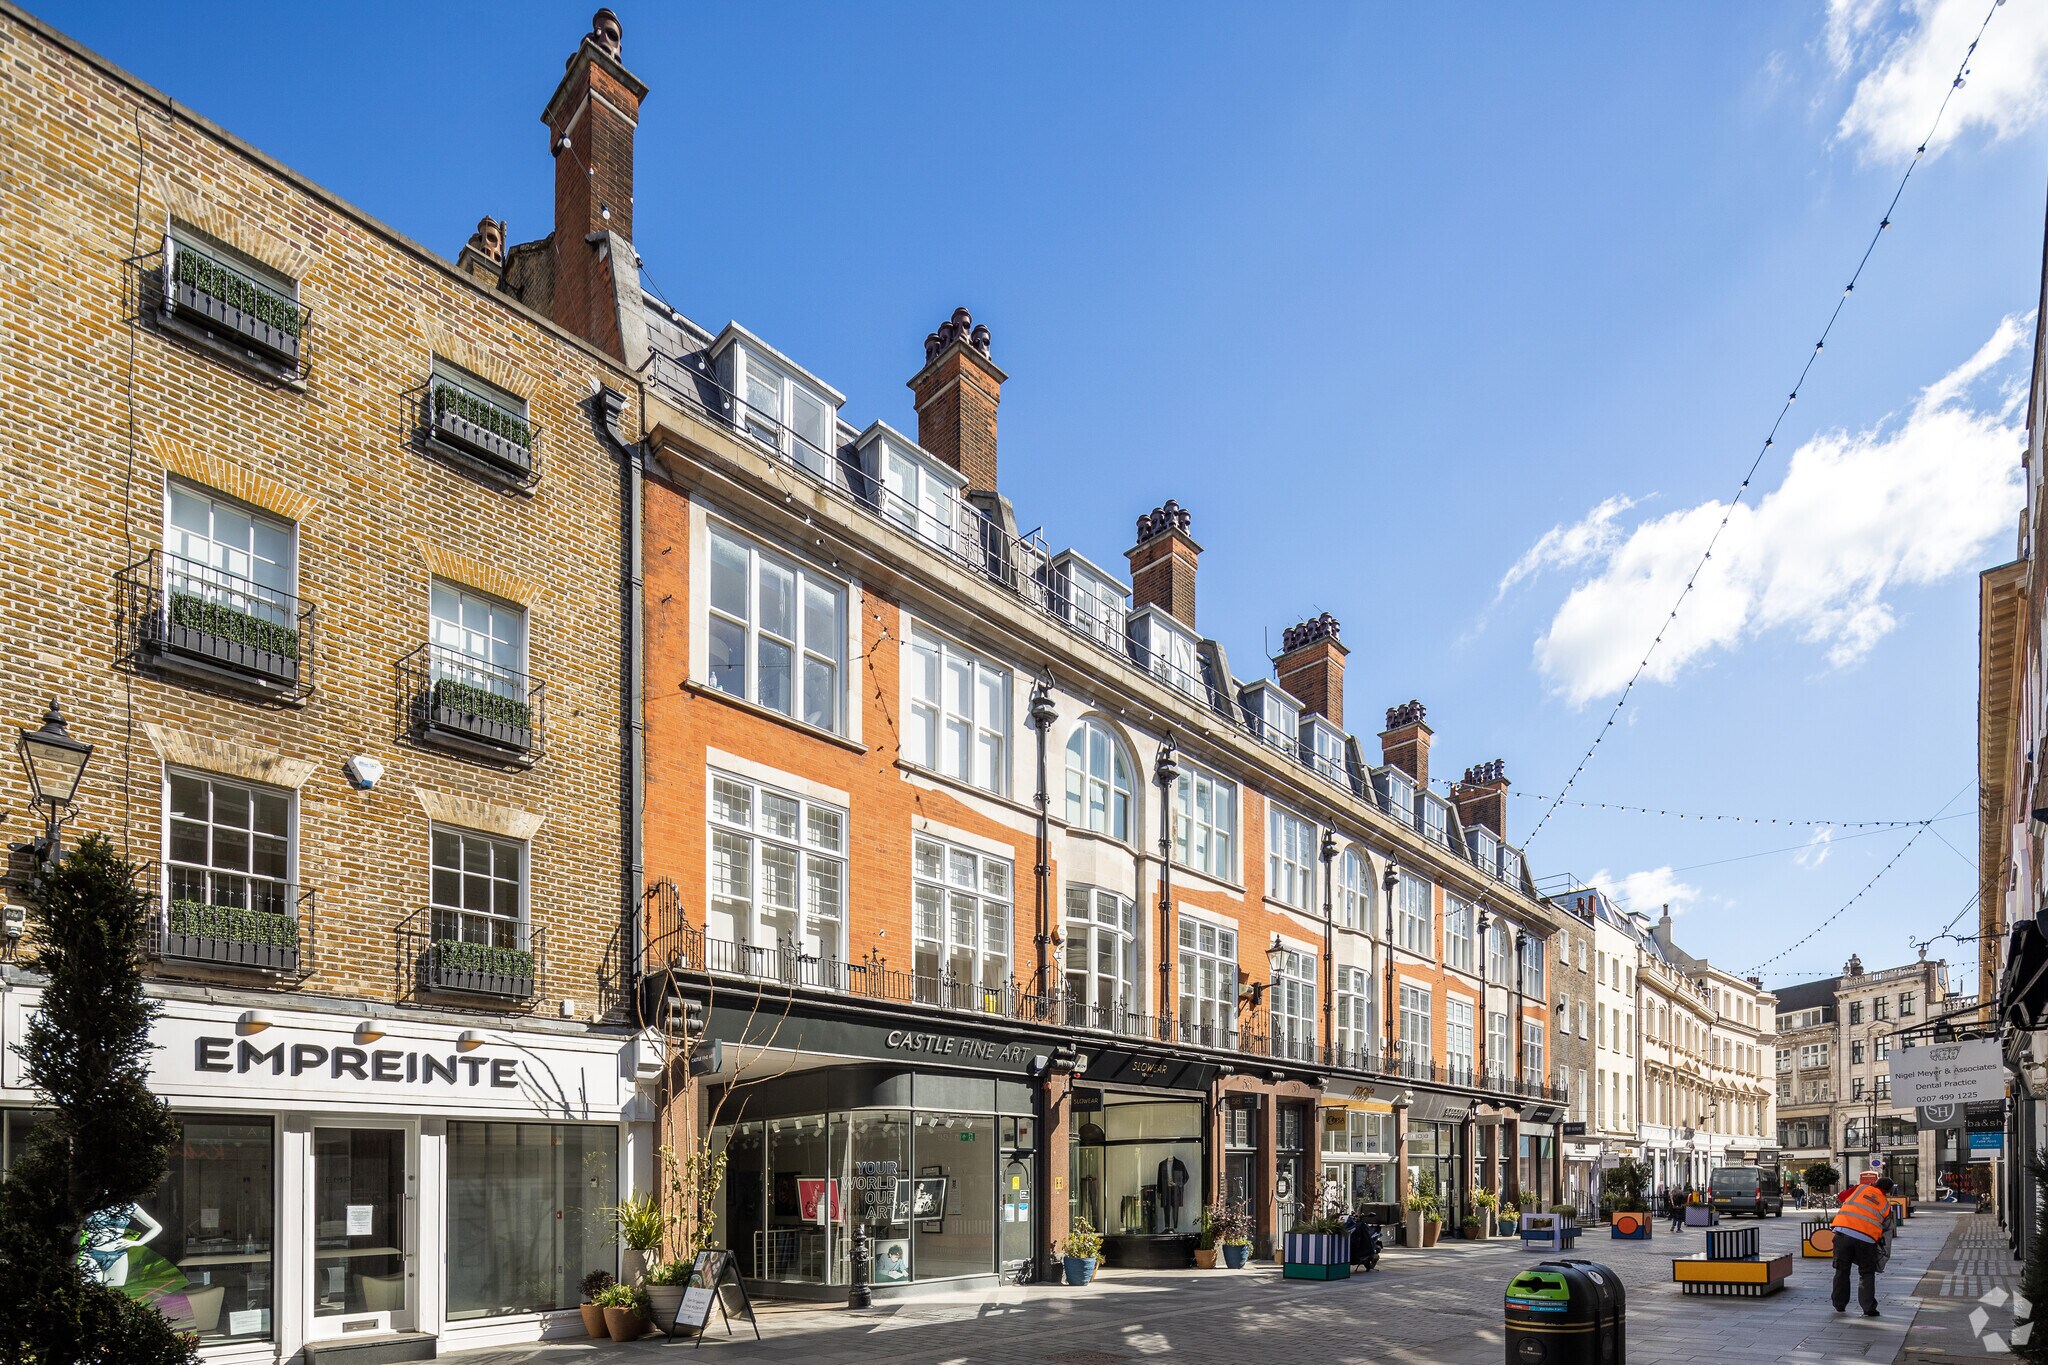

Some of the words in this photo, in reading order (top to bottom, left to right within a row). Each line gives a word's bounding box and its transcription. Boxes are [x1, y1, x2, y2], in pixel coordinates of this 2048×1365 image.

[887, 1030, 955, 1053] CASTLE
[959, 1039, 996, 1059] FINE
[1000, 1045, 1031, 1063] ART
[195, 1036, 518, 1089] EMPREINTE
[1132, 1061, 1168, 1075] SLOWEAR
[1895, 1072, 1915, 1080] Nigel
[1917, 1069, 1942, 1079] Meyer
[1954, 1064, 1997, 1074] Associates
[1915, 1081, 1942, 1091] Dental
[1944, 1079, 1977, 1088] Practice
[1353, 1086, 1375, 1099] maje
[1916, 1095, 1937, 1103] 0207
[1957, 1091, 1978, 1099] 1225
[1073, 1097, 1099, 1105] SLOWEAR
[1967, 1118, 2003, 1128] ba&sh
[856, 1160, 898, 1175] YOUR
[840, 1176, 898, 1190] WORLD
[864, 1190, 898, 1205] OUR
[865, 1205, 898, 1220] ART
